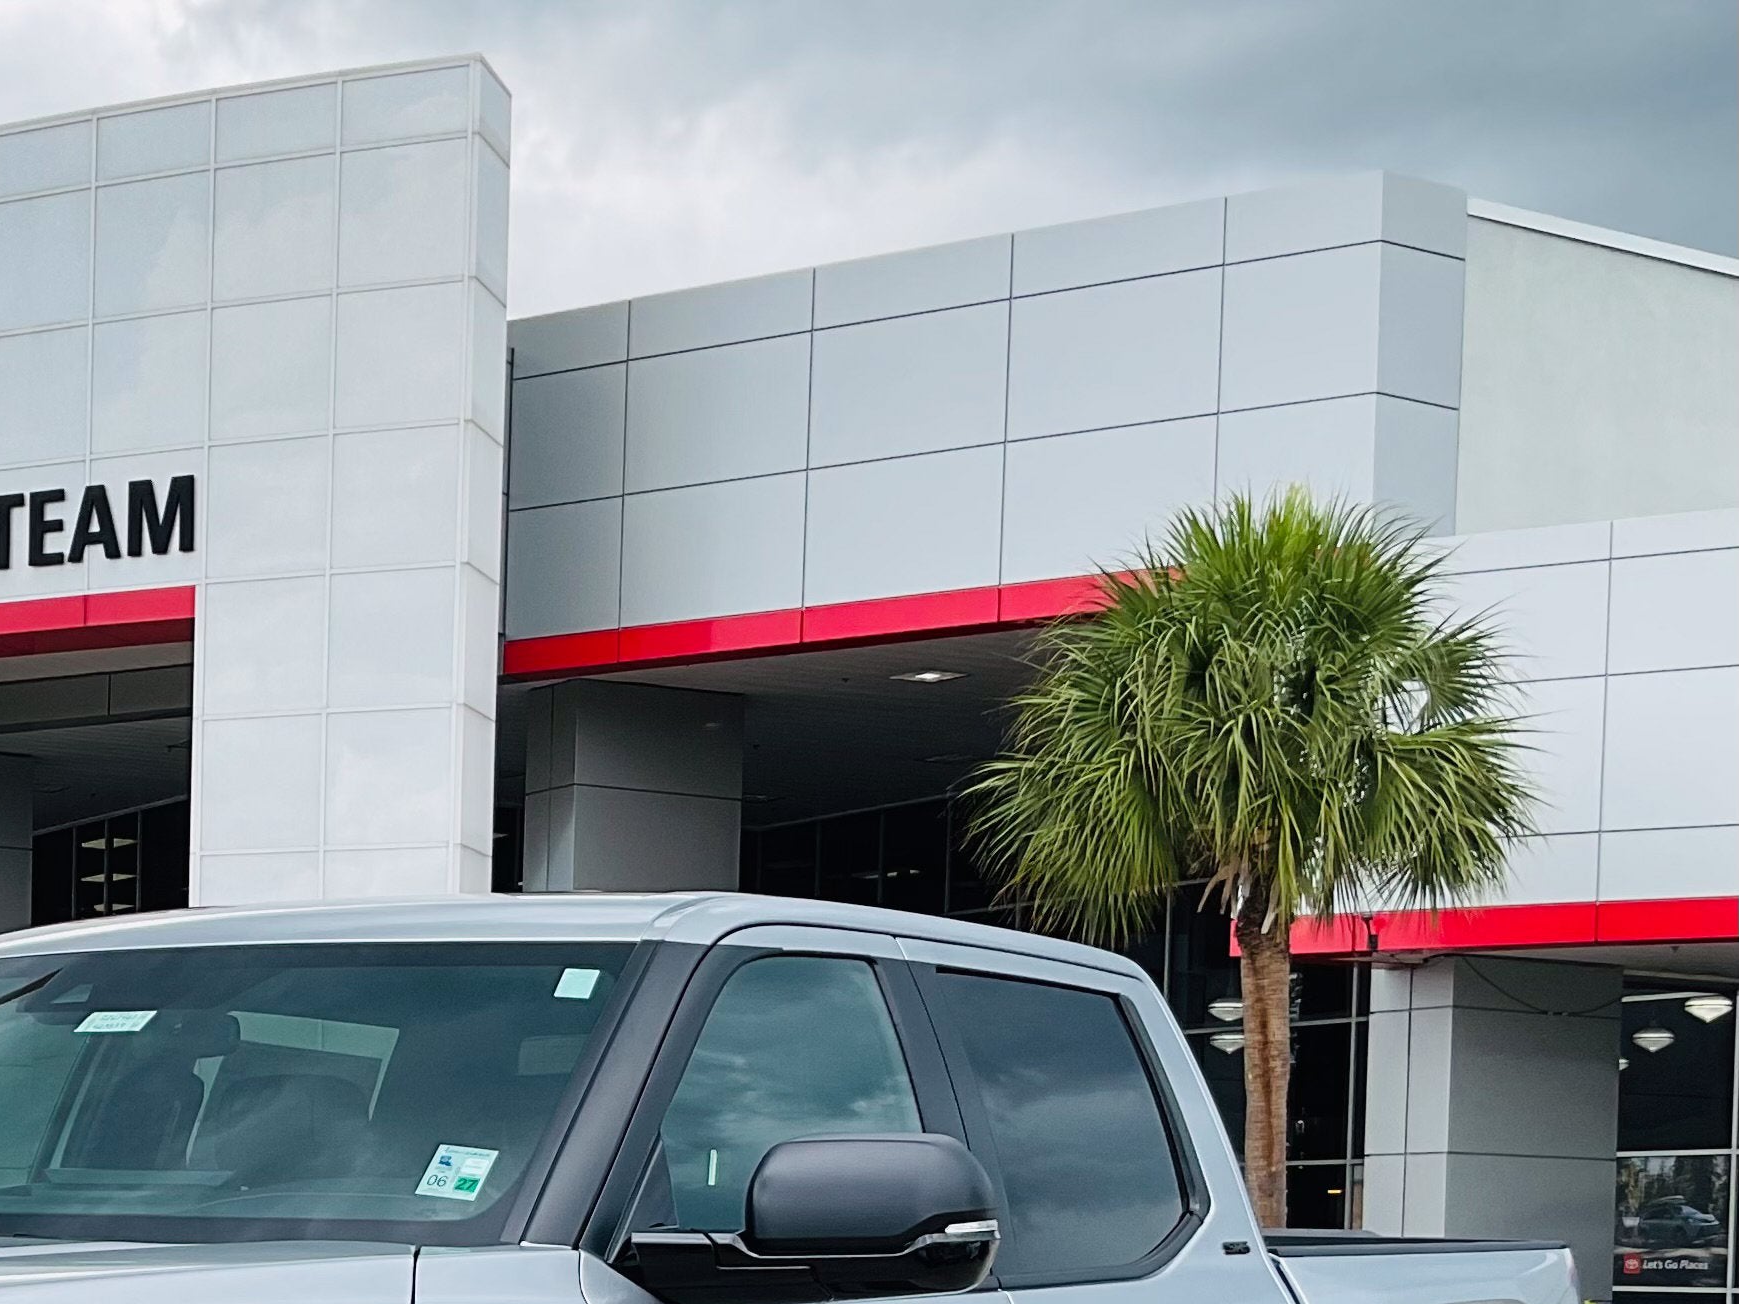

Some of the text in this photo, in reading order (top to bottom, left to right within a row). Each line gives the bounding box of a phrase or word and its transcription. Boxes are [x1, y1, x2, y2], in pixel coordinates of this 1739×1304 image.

[426, 1174, 479, 1190] 06 27
[1643, 1259, 1709, 1270] Let's Go Places
